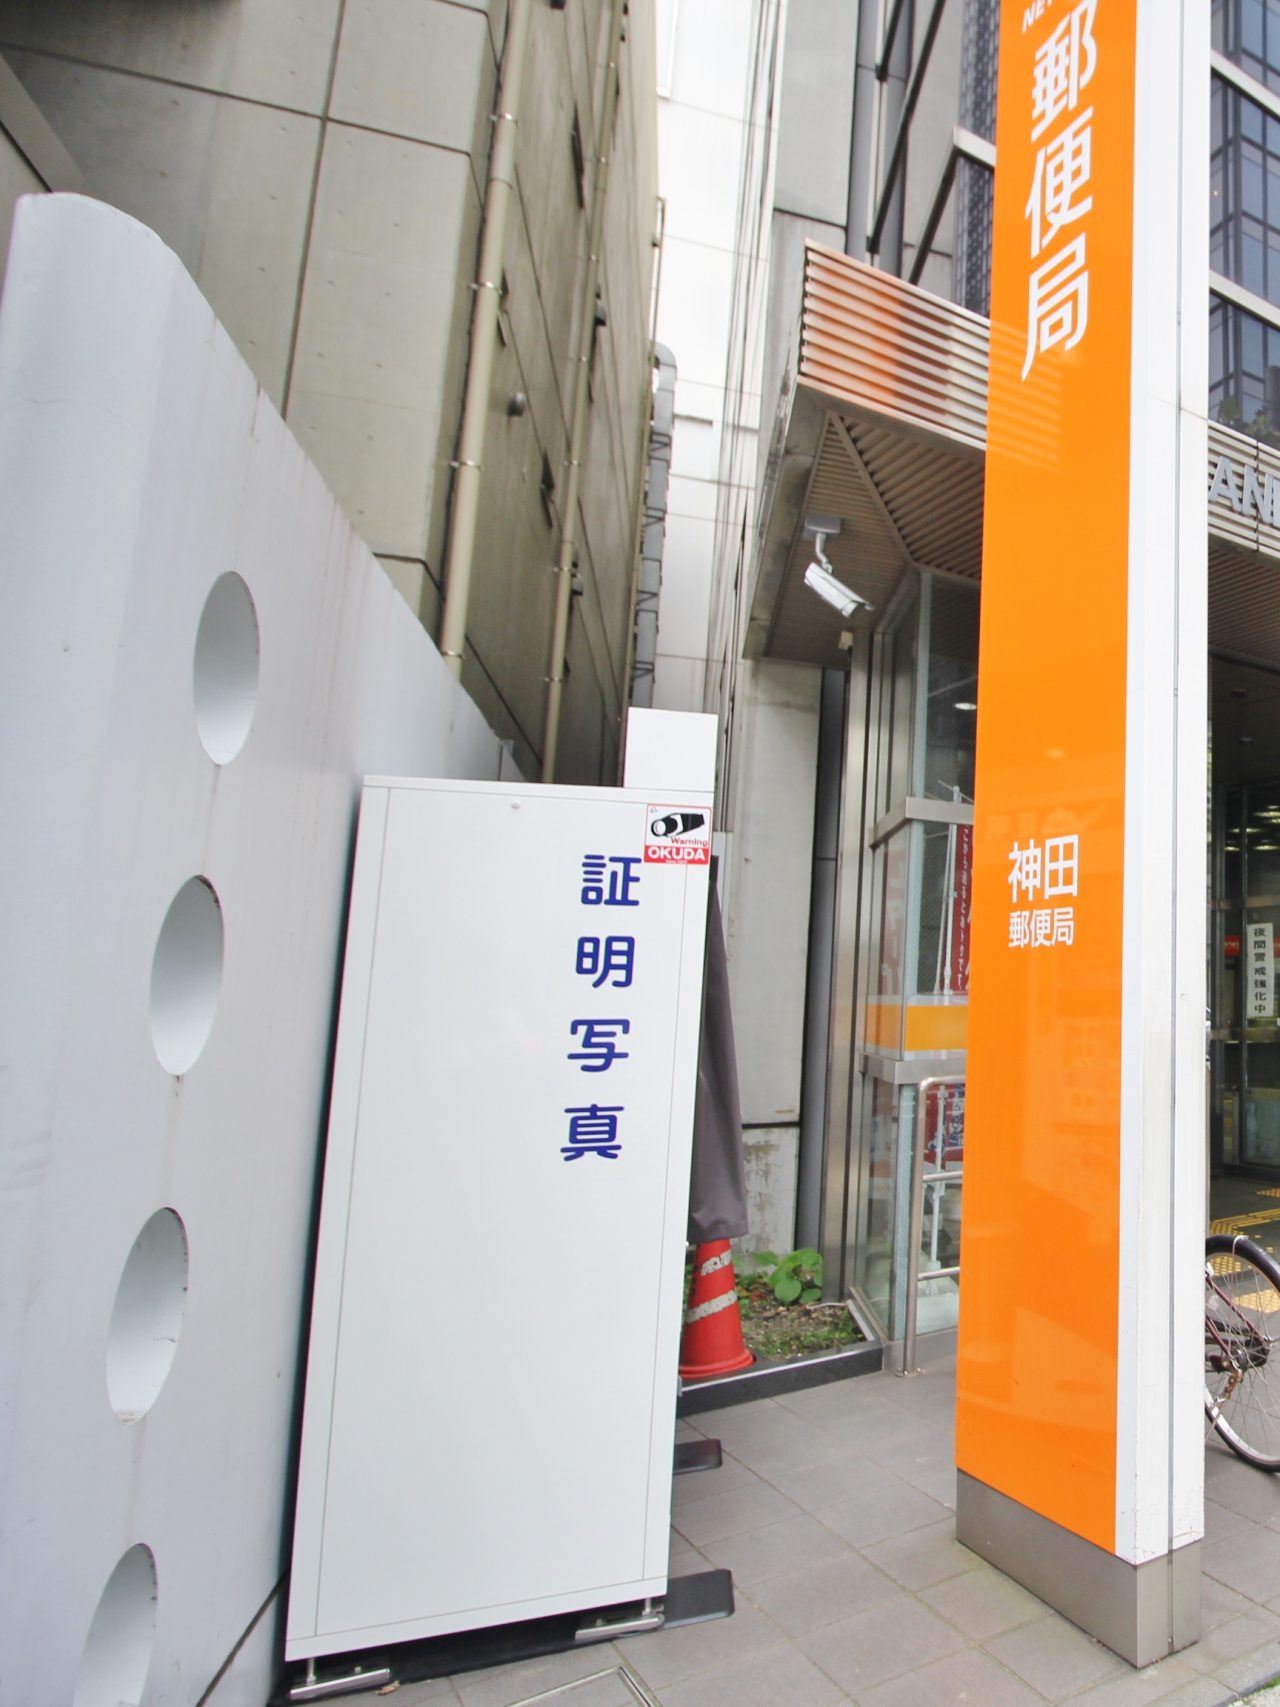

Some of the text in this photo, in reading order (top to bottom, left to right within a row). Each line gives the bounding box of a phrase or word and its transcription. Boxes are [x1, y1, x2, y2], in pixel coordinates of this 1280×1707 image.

[1021, 0, 1098, 382] 郵便局
[648, 846, 705, 861] OKUDA
[671, 837, 708, 847] Warning
[1008, 834, 1079, 903] 神田
[1008, 907, 1074, 948] 郵便局
[1253, 927, 1267, 1014] 夜間警戒強化中
[560, 854, 642, 1162] 証明写真
